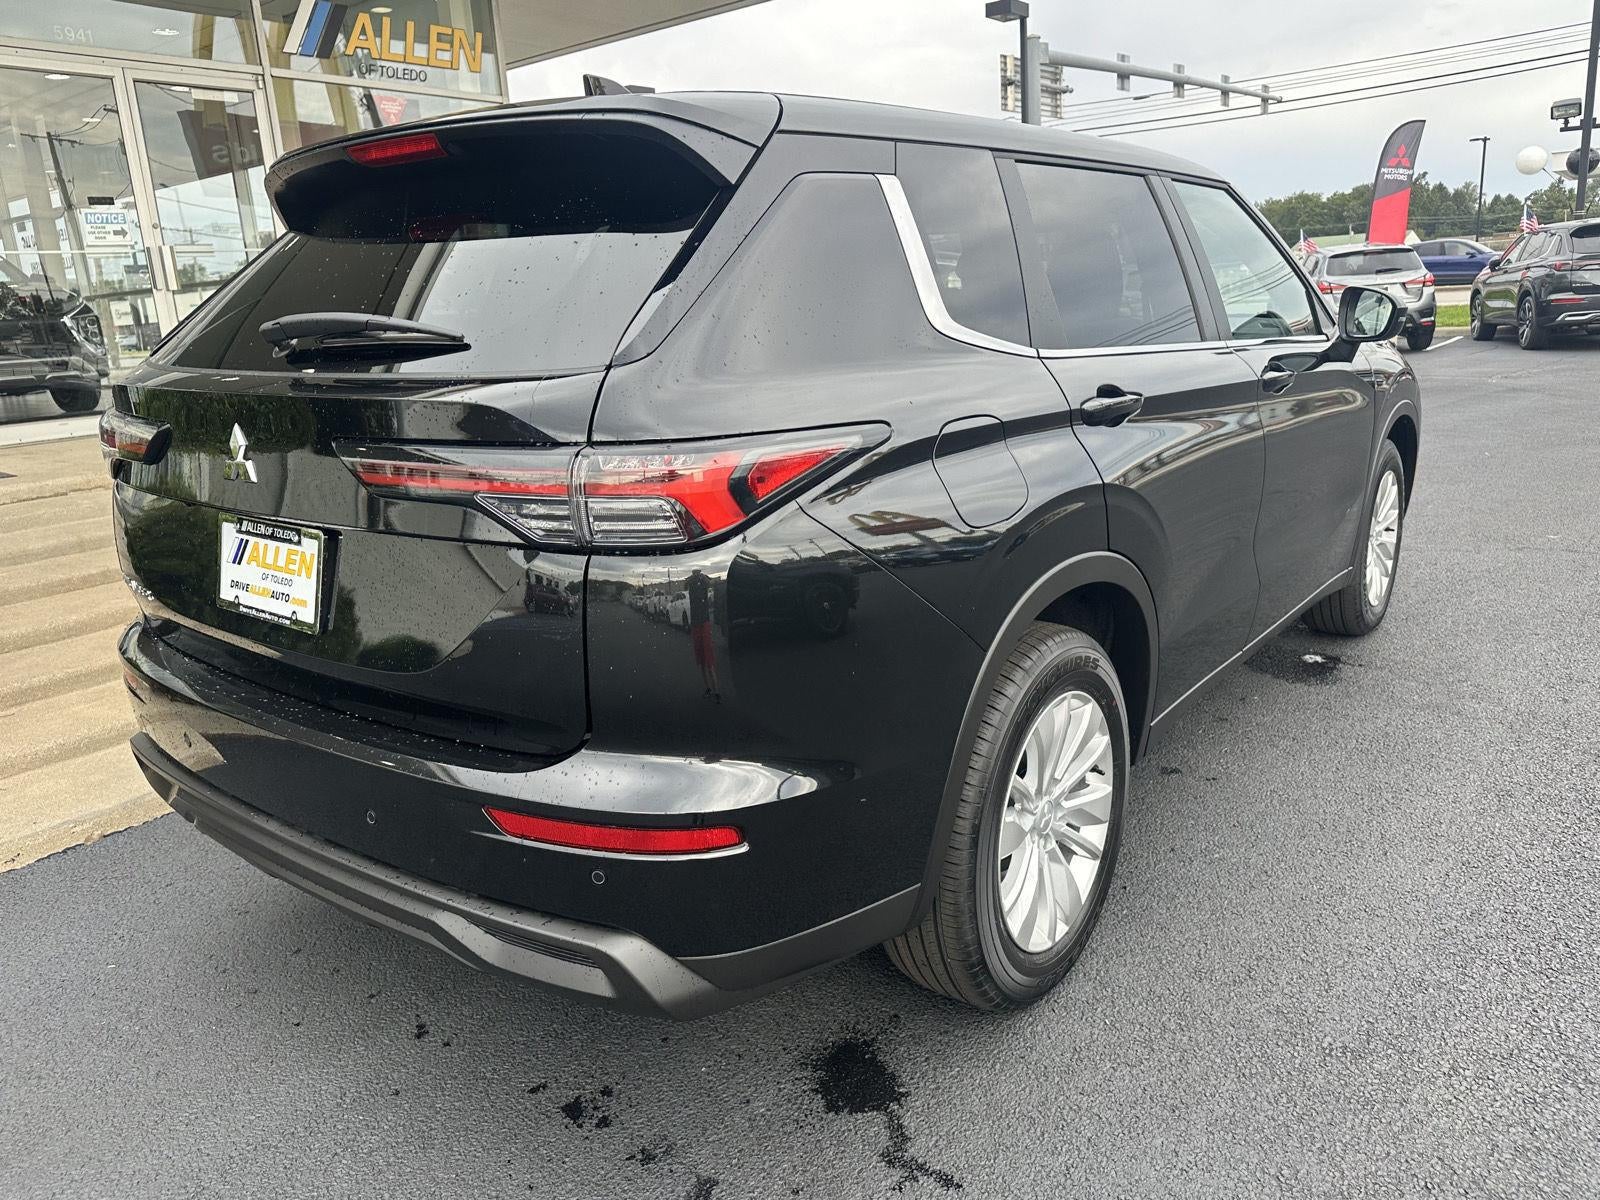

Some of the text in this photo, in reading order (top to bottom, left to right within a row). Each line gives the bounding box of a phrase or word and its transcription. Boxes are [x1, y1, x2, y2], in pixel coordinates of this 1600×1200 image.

[54, 25, 94, 46] 5941
[344, 12, 483, 73] ALLEN
[358, 63, 428, 82] OF TOLEDO
[86, 212, 127, 225] NOTICE
[246, 522, 265, 535] ALLEN
[246, 541, 316, 579] ALLEN
[261, 572, 293, 588] OF TOLEDO
